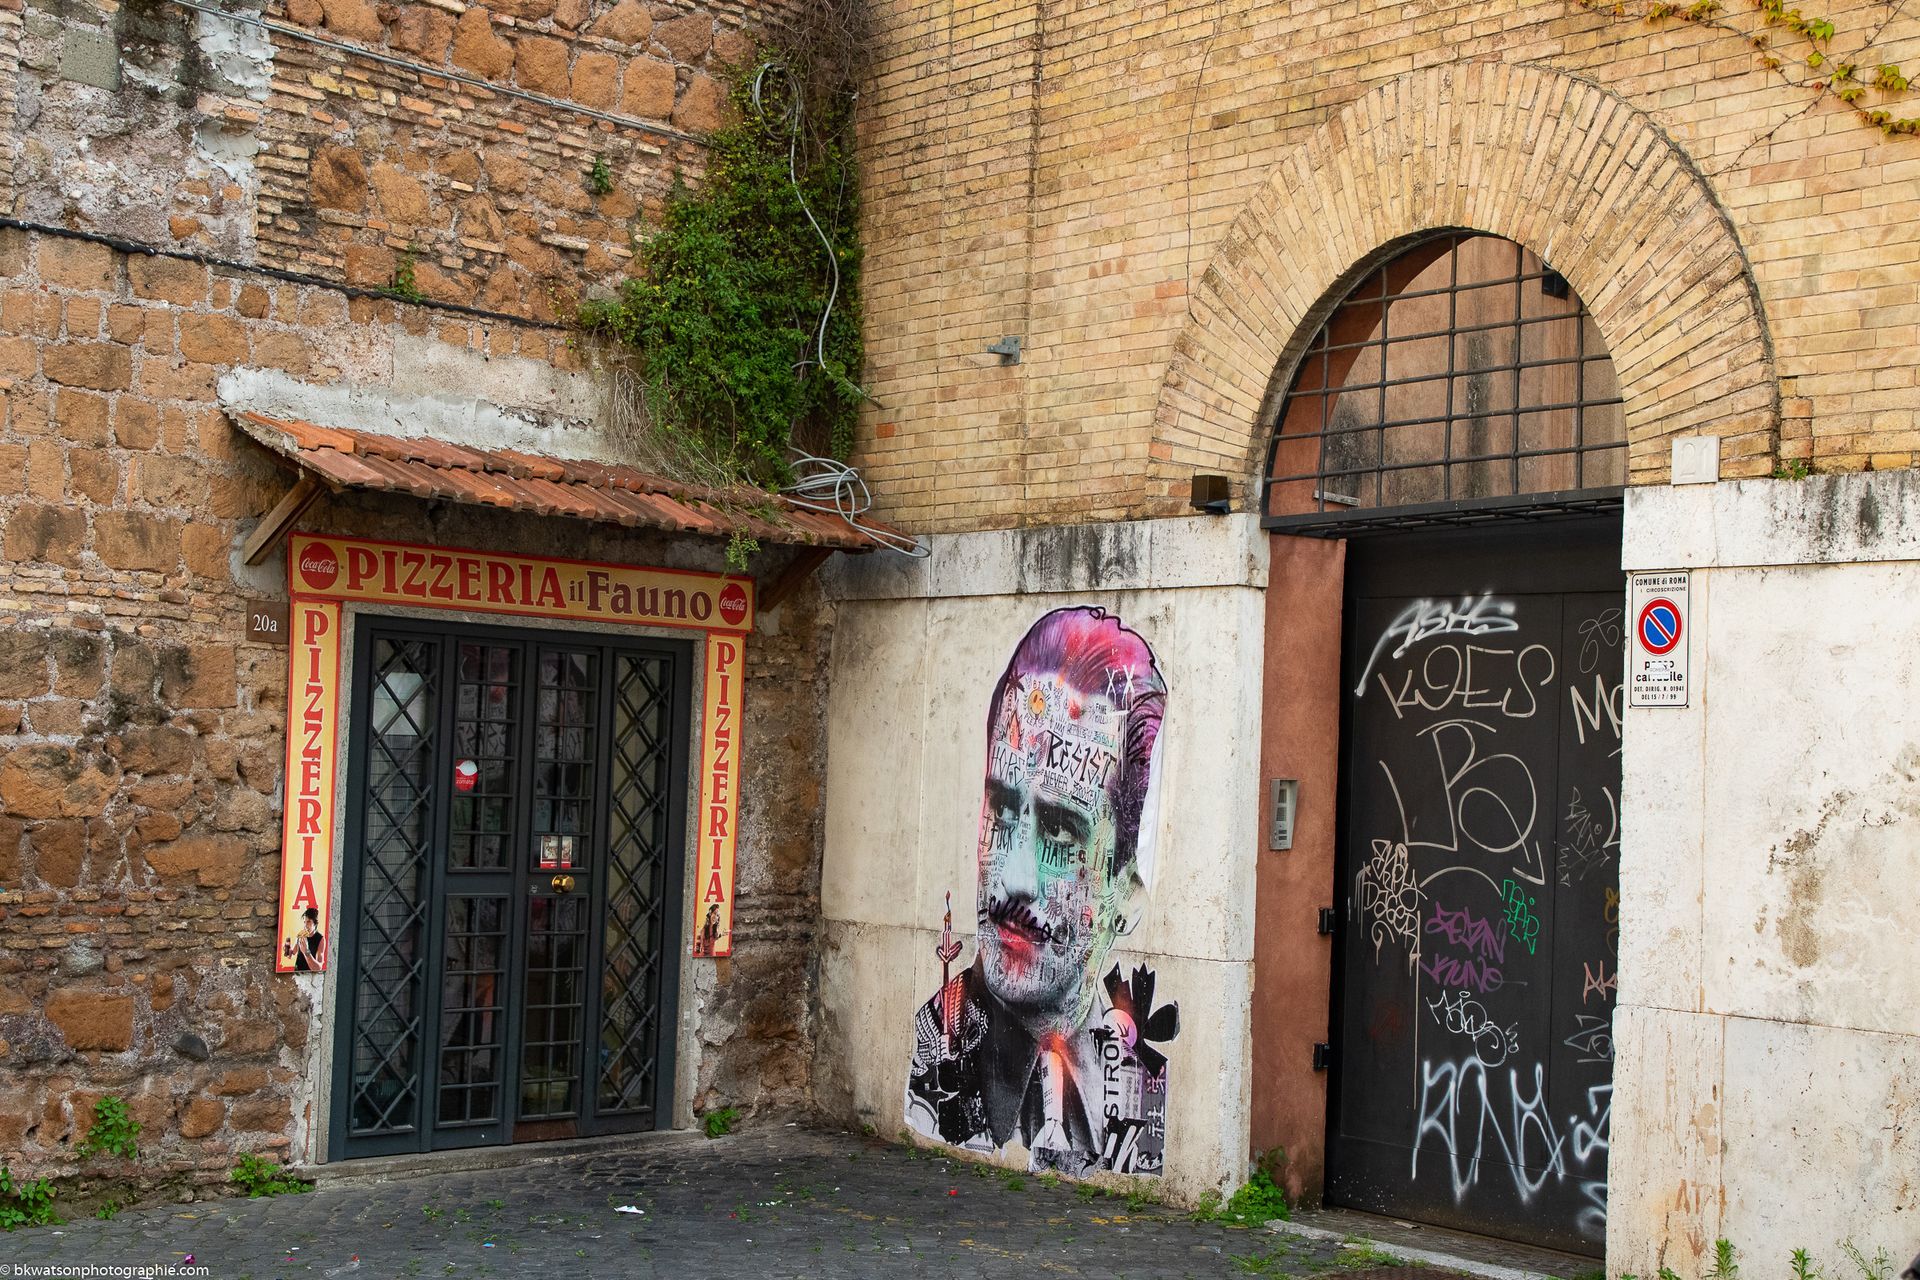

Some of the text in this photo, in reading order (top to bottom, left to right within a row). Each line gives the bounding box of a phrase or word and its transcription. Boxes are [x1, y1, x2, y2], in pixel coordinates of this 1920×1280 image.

[345, 546, 713, 621] PIZZERIA il Fauno
[1635, 576, 1687, 586] COMUNE di ROMA
[253, 613, 277, 632] 20a
[1636, 671, 1683, 682] caile
[291, 608, 330, 910] PIZZERIA
[703, 640, 737, 903] PIZZERIA
[1045, 730, 1118, 789] RESIST
[1043, 769, 1069, 792] NEVER
[1041, 839, 1075, 868] HATE
